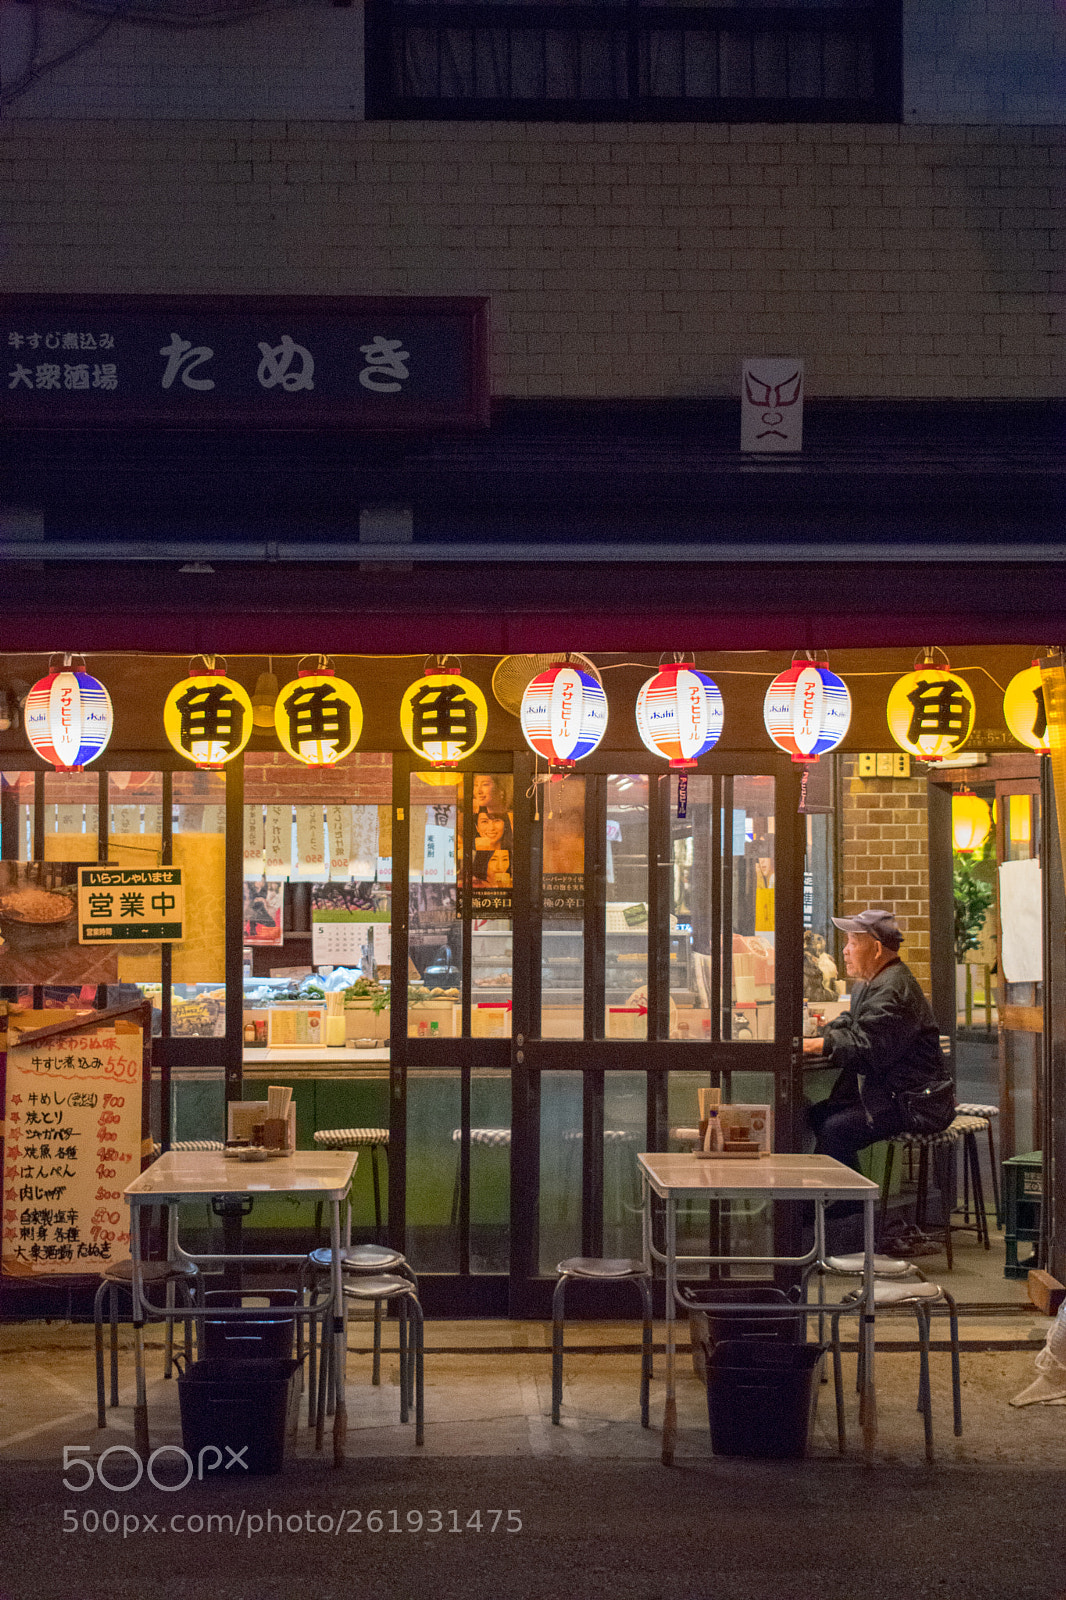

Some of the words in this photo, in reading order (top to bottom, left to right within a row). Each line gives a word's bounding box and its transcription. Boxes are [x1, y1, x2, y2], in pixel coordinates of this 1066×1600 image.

[8, 331, 115, 350] 牛すじ煮込み
[159, 332, 411, 393] たぬき
[8, 363, 119, 390] 大衆酒場
[60, 688, 73, 743] アサヒビール
[175, 683, 246, 754] 角
[283, 683, 351, 754] 角
[410, 683, 478, 753] 角
[559, 682, 574, 738] アサヒビール
[650, 709, 674, 719] Asahi
[689, 686, 701, 740] アサヒビール
[800, 682, 816, 735] アサヒビール
[906, 679, 971, 749] 角
[90, 872, 174, 884] いらっしゃいませ
[88, 891, 175, 918] 営業中
[31, 1055, 104, 1072] 牛すじ煮込み
[104, 1055, 137, 1077] 550
[28, 1091, 66, 1106] 牛めし
[102, 1093, 125, 1109] 700
[25, 1110, 63, 1125] 焼とり
[20, 1164, 76, 1178] はんぺん
[19, 1184, 67, 1201] 肉じゃが
